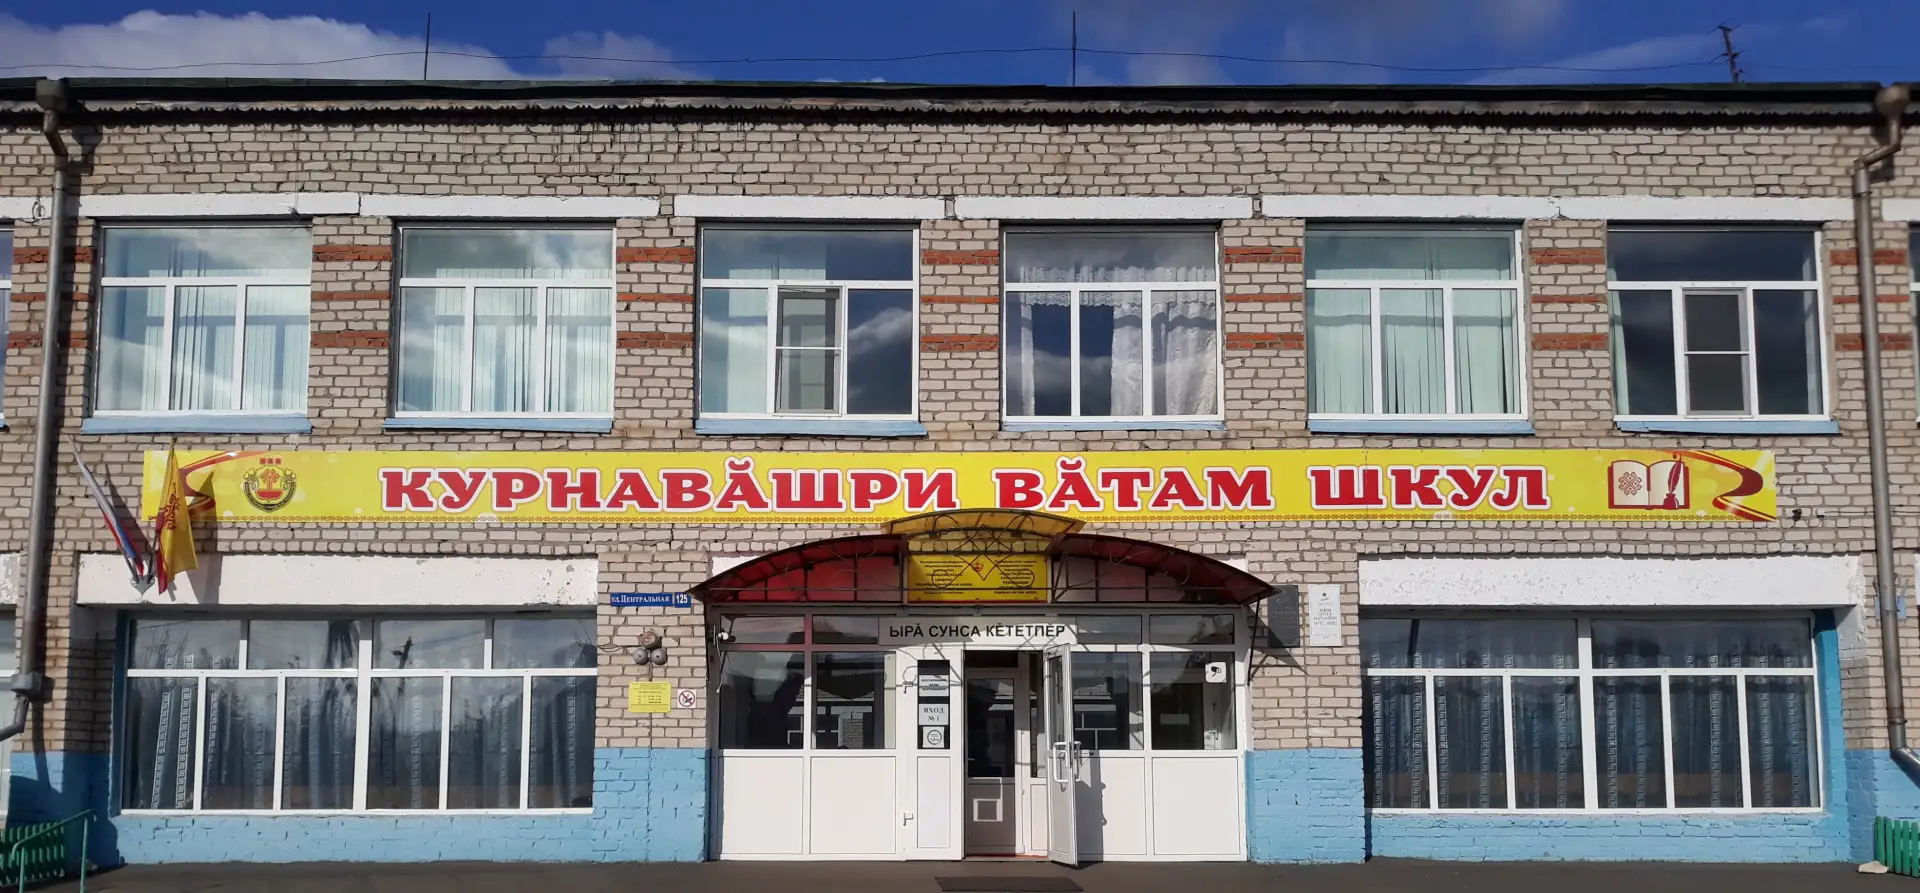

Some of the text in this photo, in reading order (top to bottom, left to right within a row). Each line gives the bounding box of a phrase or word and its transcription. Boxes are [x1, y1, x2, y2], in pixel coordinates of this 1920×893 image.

[380, 459, 1548, 510] КУРНАВӐШРИ ВӐТАМ ШКУЛ
[676, 593, 688, 604] 125
[889, 622, 1066, 638] ЫРӐ СУНСА КӖТЕТПӖР
